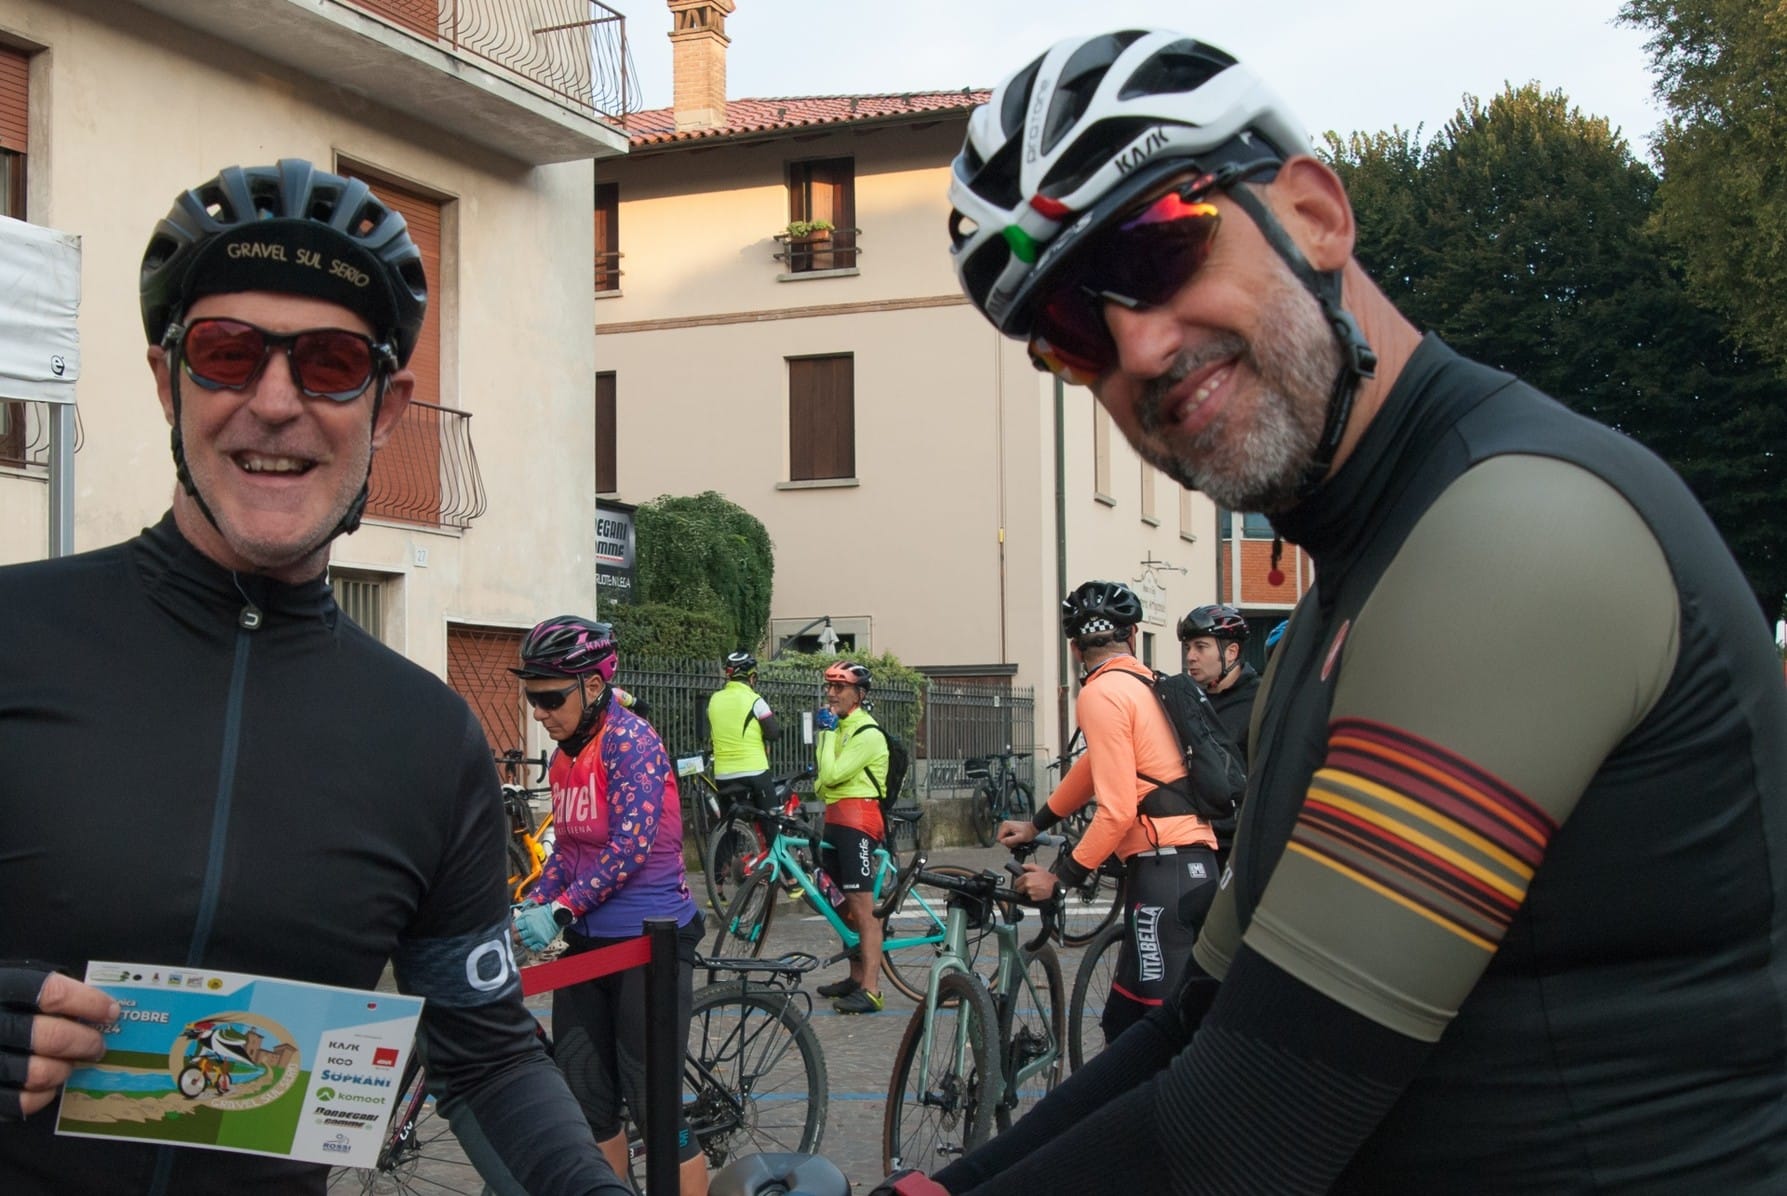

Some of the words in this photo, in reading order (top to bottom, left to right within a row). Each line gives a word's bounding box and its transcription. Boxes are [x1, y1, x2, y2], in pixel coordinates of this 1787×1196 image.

[1114, 126, 1170, 175] KASK
[227, 242, 288, 262] GRAVEL
[295, 248, 322, 269] SUL
[328, 258, 370, 287] SERIO
[595, 517, 627, 541] EGANI
[595, 540, 625, 556] MME
[860, 838, 871, 877] Cofidis
[1137, 905, 1163, 982] VITABELLA
[328, 1040, 360, 1052] KASK
[338, 1092, 386, 1105] komoot
